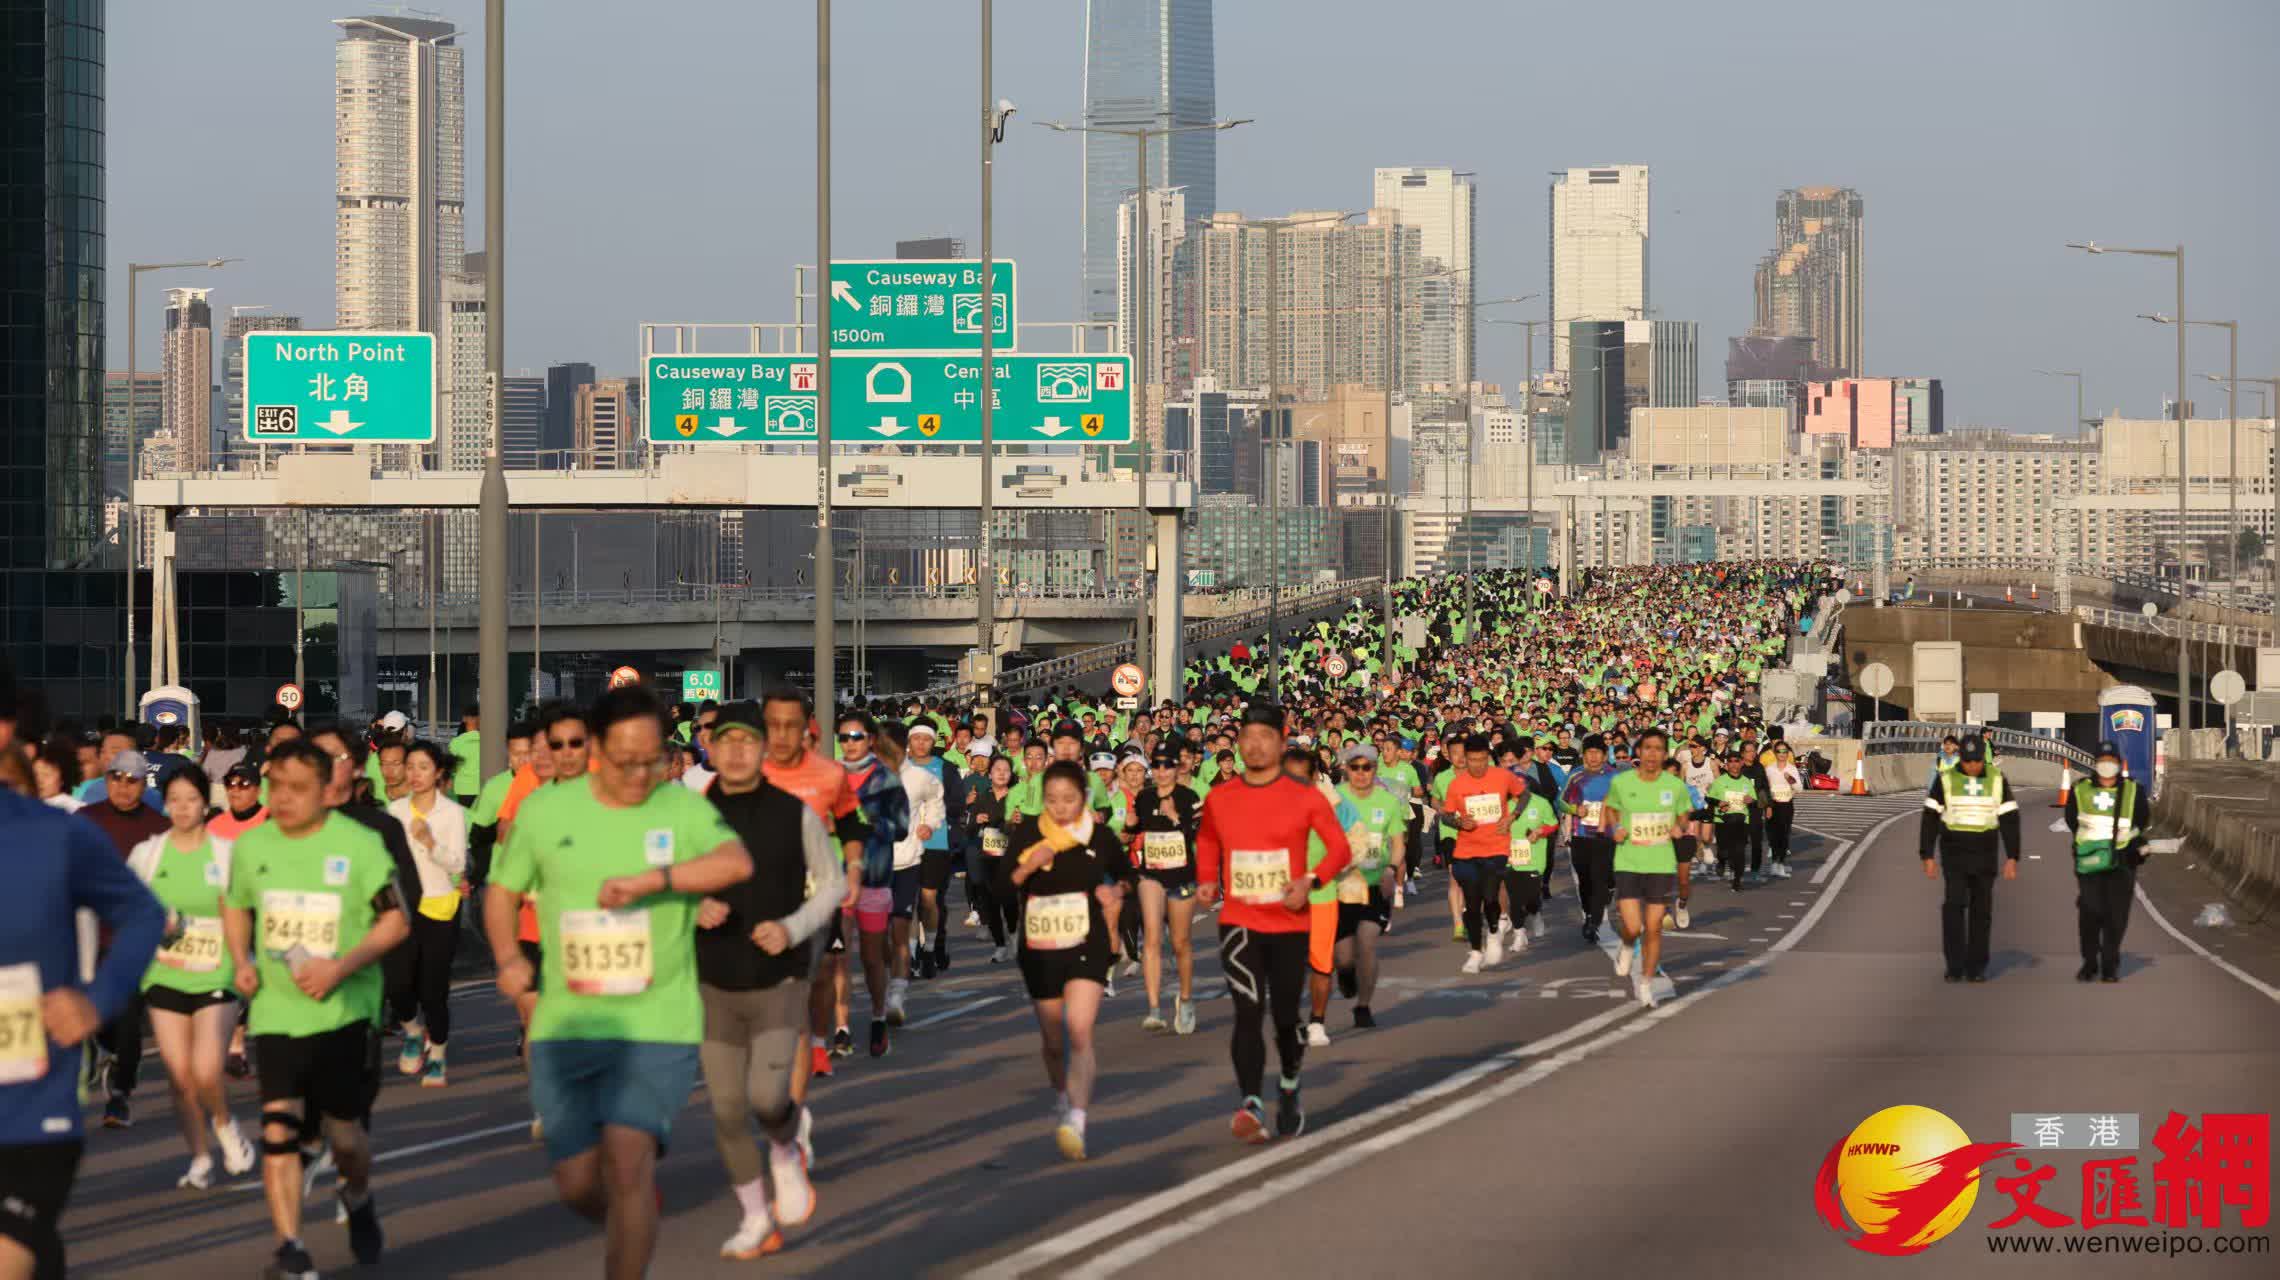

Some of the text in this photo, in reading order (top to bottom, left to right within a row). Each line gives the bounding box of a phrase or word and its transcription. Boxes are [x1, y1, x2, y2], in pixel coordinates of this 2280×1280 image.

[867, 270, 957, 288] Causeway
[869, 294, 945, 317] 銅鑼灣
[832, 329, 885, 343] 1500m
[275, 343, 405, 361] North Point
[655, 364, 786, 382] Causeway Bay
[308, 372, 369, 402] 北角
[681, 387, 759, 410] 銅鑼灣
[259, 408, 279, 418] EXIT
[279, 408, 294, 431] 6
[680, 417, 693, 432] 4
[923, 417, 936, 432] 4
[1086, 417, 1099, 432] 4
[1330, 663, 1342, 671] 70
[689, 672, 713, 686] 6.0
[281, 692, 299, 702] 50
[1028, 914, 1085, 933] S0167
[565, 941, 647, 971] S1357
